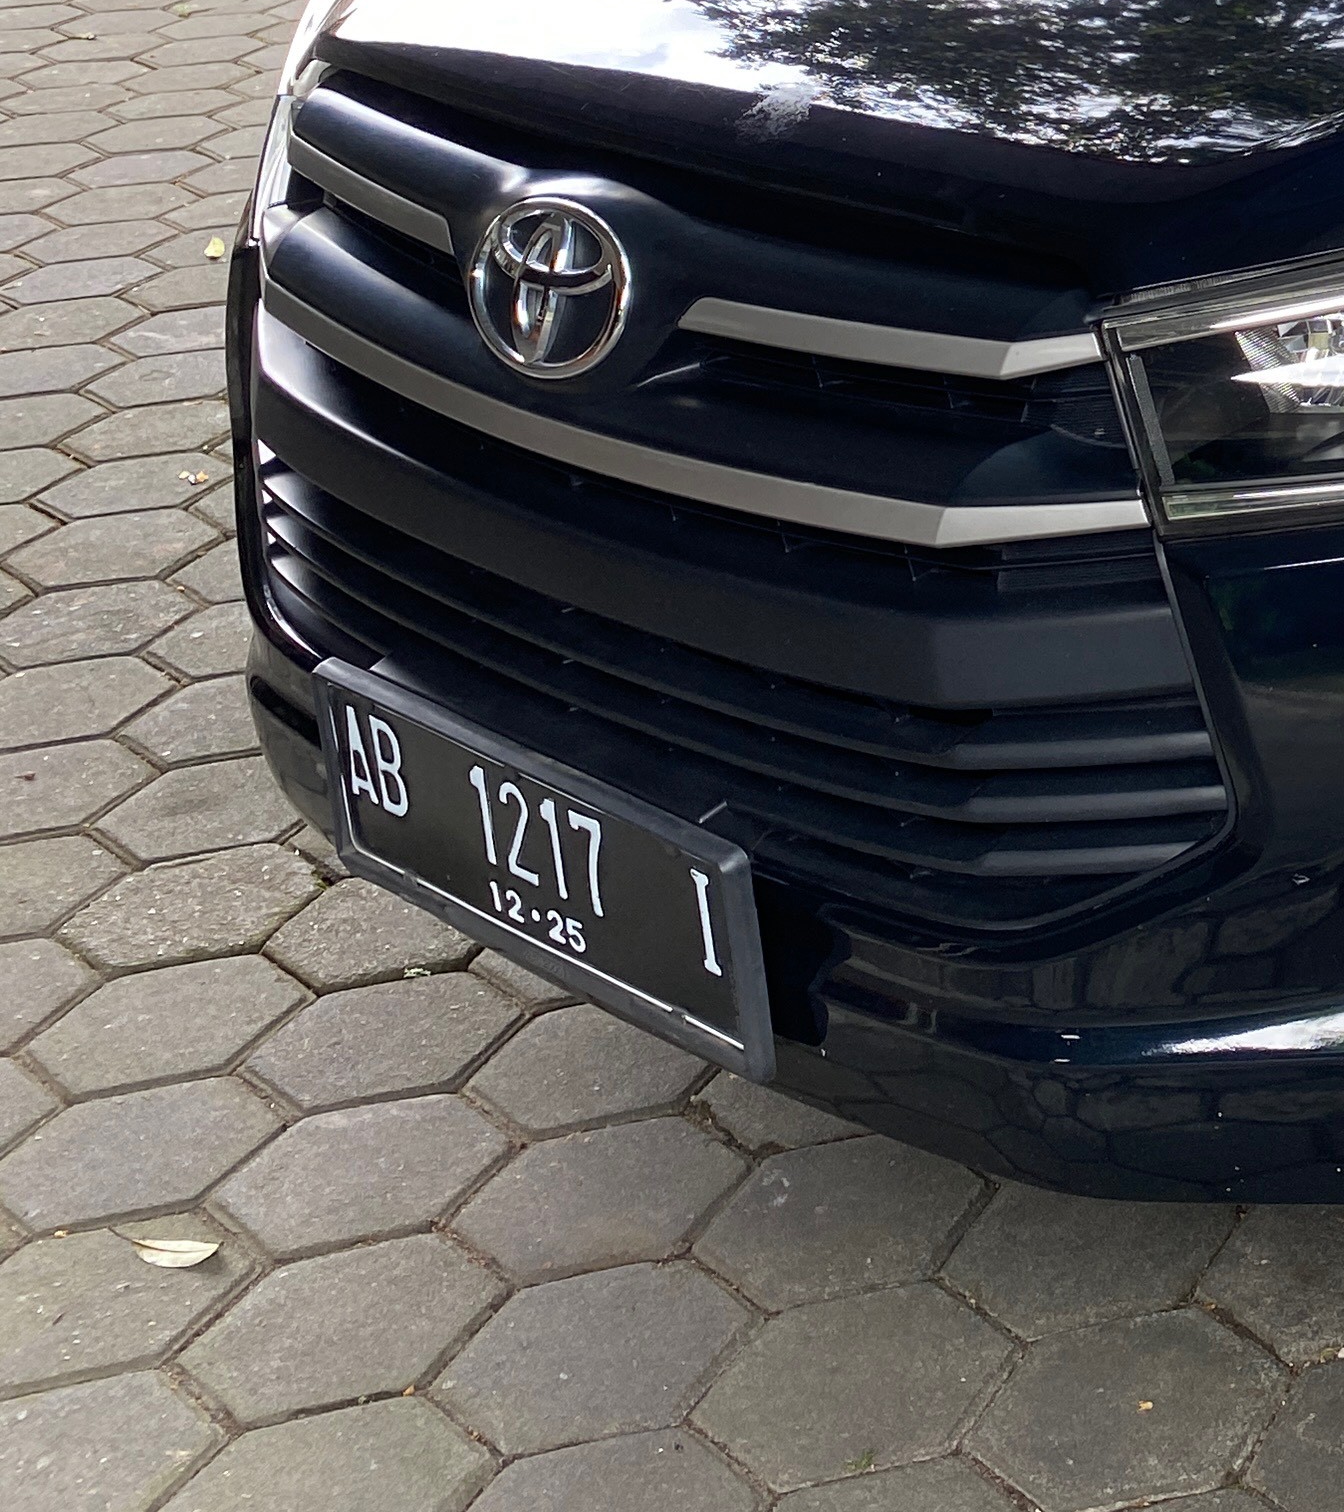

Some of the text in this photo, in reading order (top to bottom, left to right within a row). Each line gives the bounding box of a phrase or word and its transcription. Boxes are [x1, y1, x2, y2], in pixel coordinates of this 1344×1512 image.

[345, 704, 722, 976] AB 1217 I
